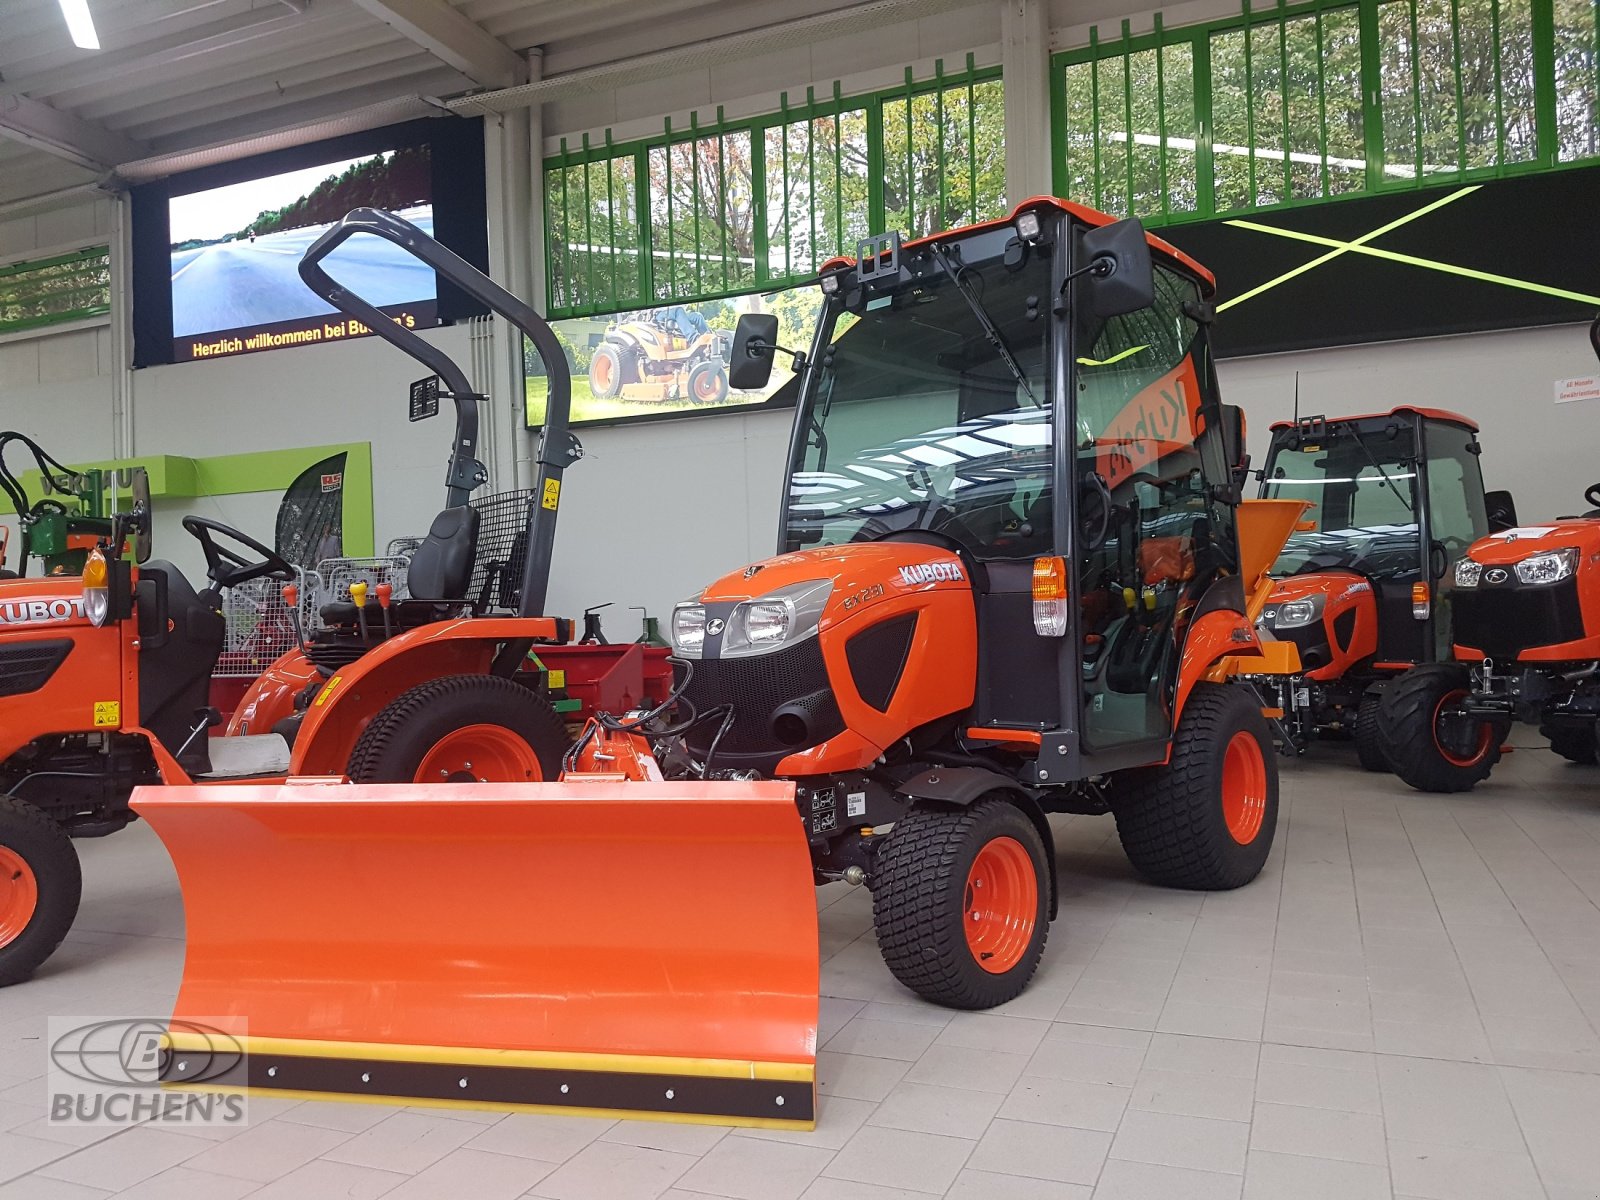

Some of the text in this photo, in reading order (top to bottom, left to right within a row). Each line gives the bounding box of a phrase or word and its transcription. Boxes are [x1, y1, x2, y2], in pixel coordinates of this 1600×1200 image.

[193, 337, 242, 357] Herzlich
[245, 328, 321, 350] willkommen
[324, 322, 346, 338] bei
[898, 562, 965, 586] KUBOTA
[0, 599, 86, 624] UBOT
